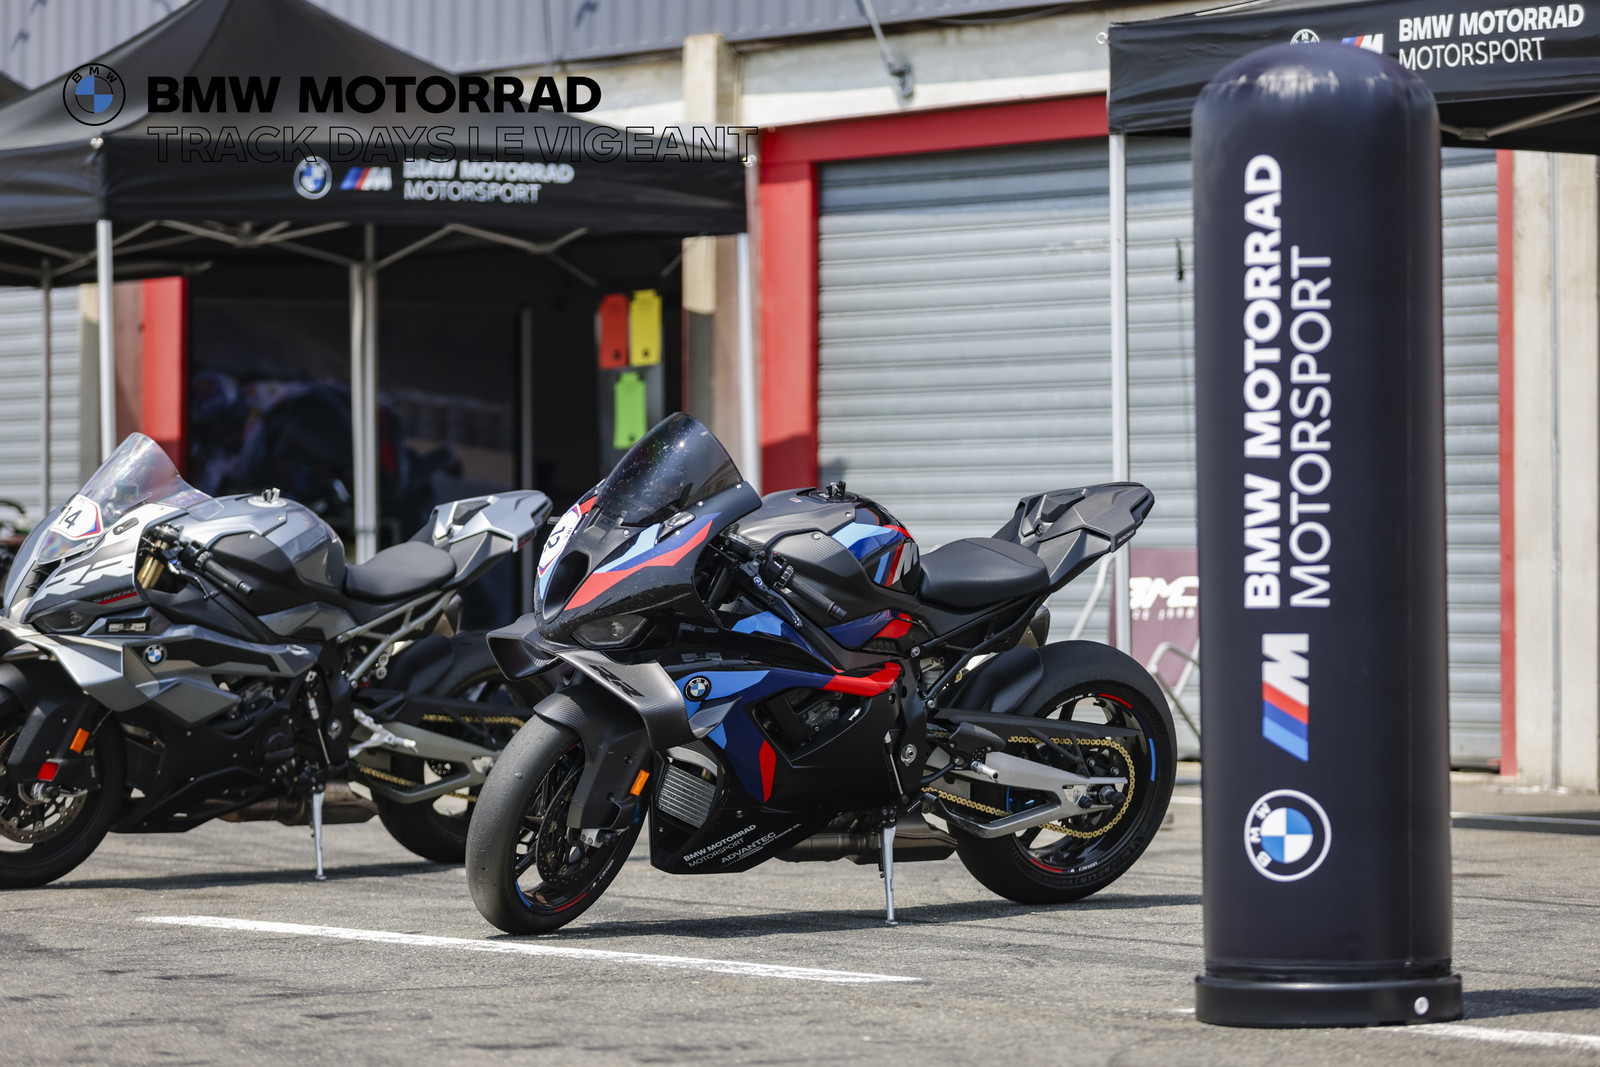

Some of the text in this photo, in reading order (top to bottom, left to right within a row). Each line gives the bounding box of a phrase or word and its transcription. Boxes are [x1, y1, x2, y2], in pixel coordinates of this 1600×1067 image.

[1399, 4, 1585, 42] BMW MOTORRAD
[1399, 37, 1545, 71] MOTORSPORT
[403, 158, 576, 184] BMW MOTORRAD
[404, 180, 542, 204] MOTORSPORT
[1243, 154, 1282, 609] BMW MOTORRAD
[1289, 245, 1332, 608] MOTORSPORT
[58, 506, 83, 529] 14
[683, 824, 757, 862] BMW MOTORRAD
[721, 831, 777, 864] ADVANTEC
[1249, 801, 1273, 869] BMW
[688, 838, 745, 868] MOTORSPORT
